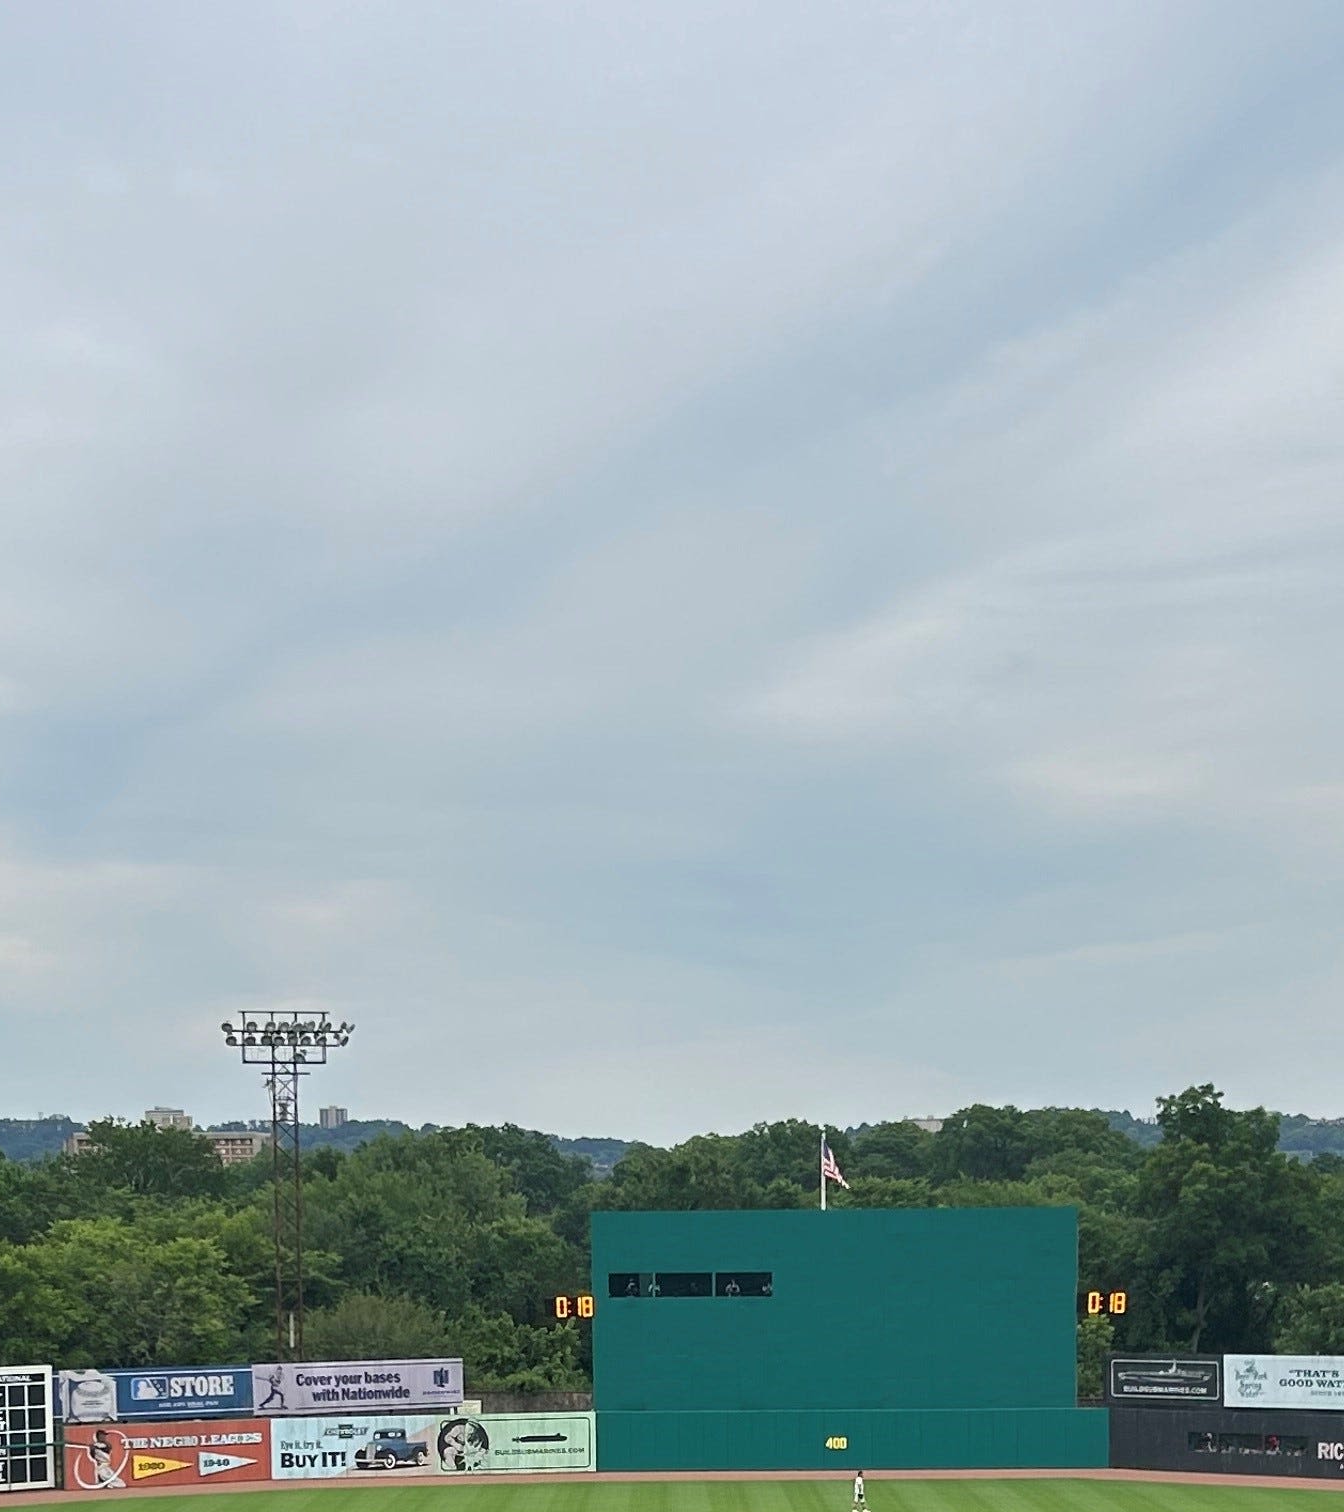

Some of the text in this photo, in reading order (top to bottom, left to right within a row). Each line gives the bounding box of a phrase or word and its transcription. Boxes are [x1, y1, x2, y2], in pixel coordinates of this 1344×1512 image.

[556, 1296, 594, 1318] 0:18
[1088, 1292, 1126, 1314] 0:18
[170, 1375, 235, 1398] STORE
[296, 1371, 401, 1388] Cover your bases
[1279, 1379, 1314, 1388] GOOD
[312, 1388, 341, 1402] with
[341, 1386, 411, 1402] Nationwide
[120, 1432, 263, 1449] THE NEGRO LEAGUES
[825, 1437, 847, 1449] 400
[280, 1451, 347, 1468] BUY IT!
